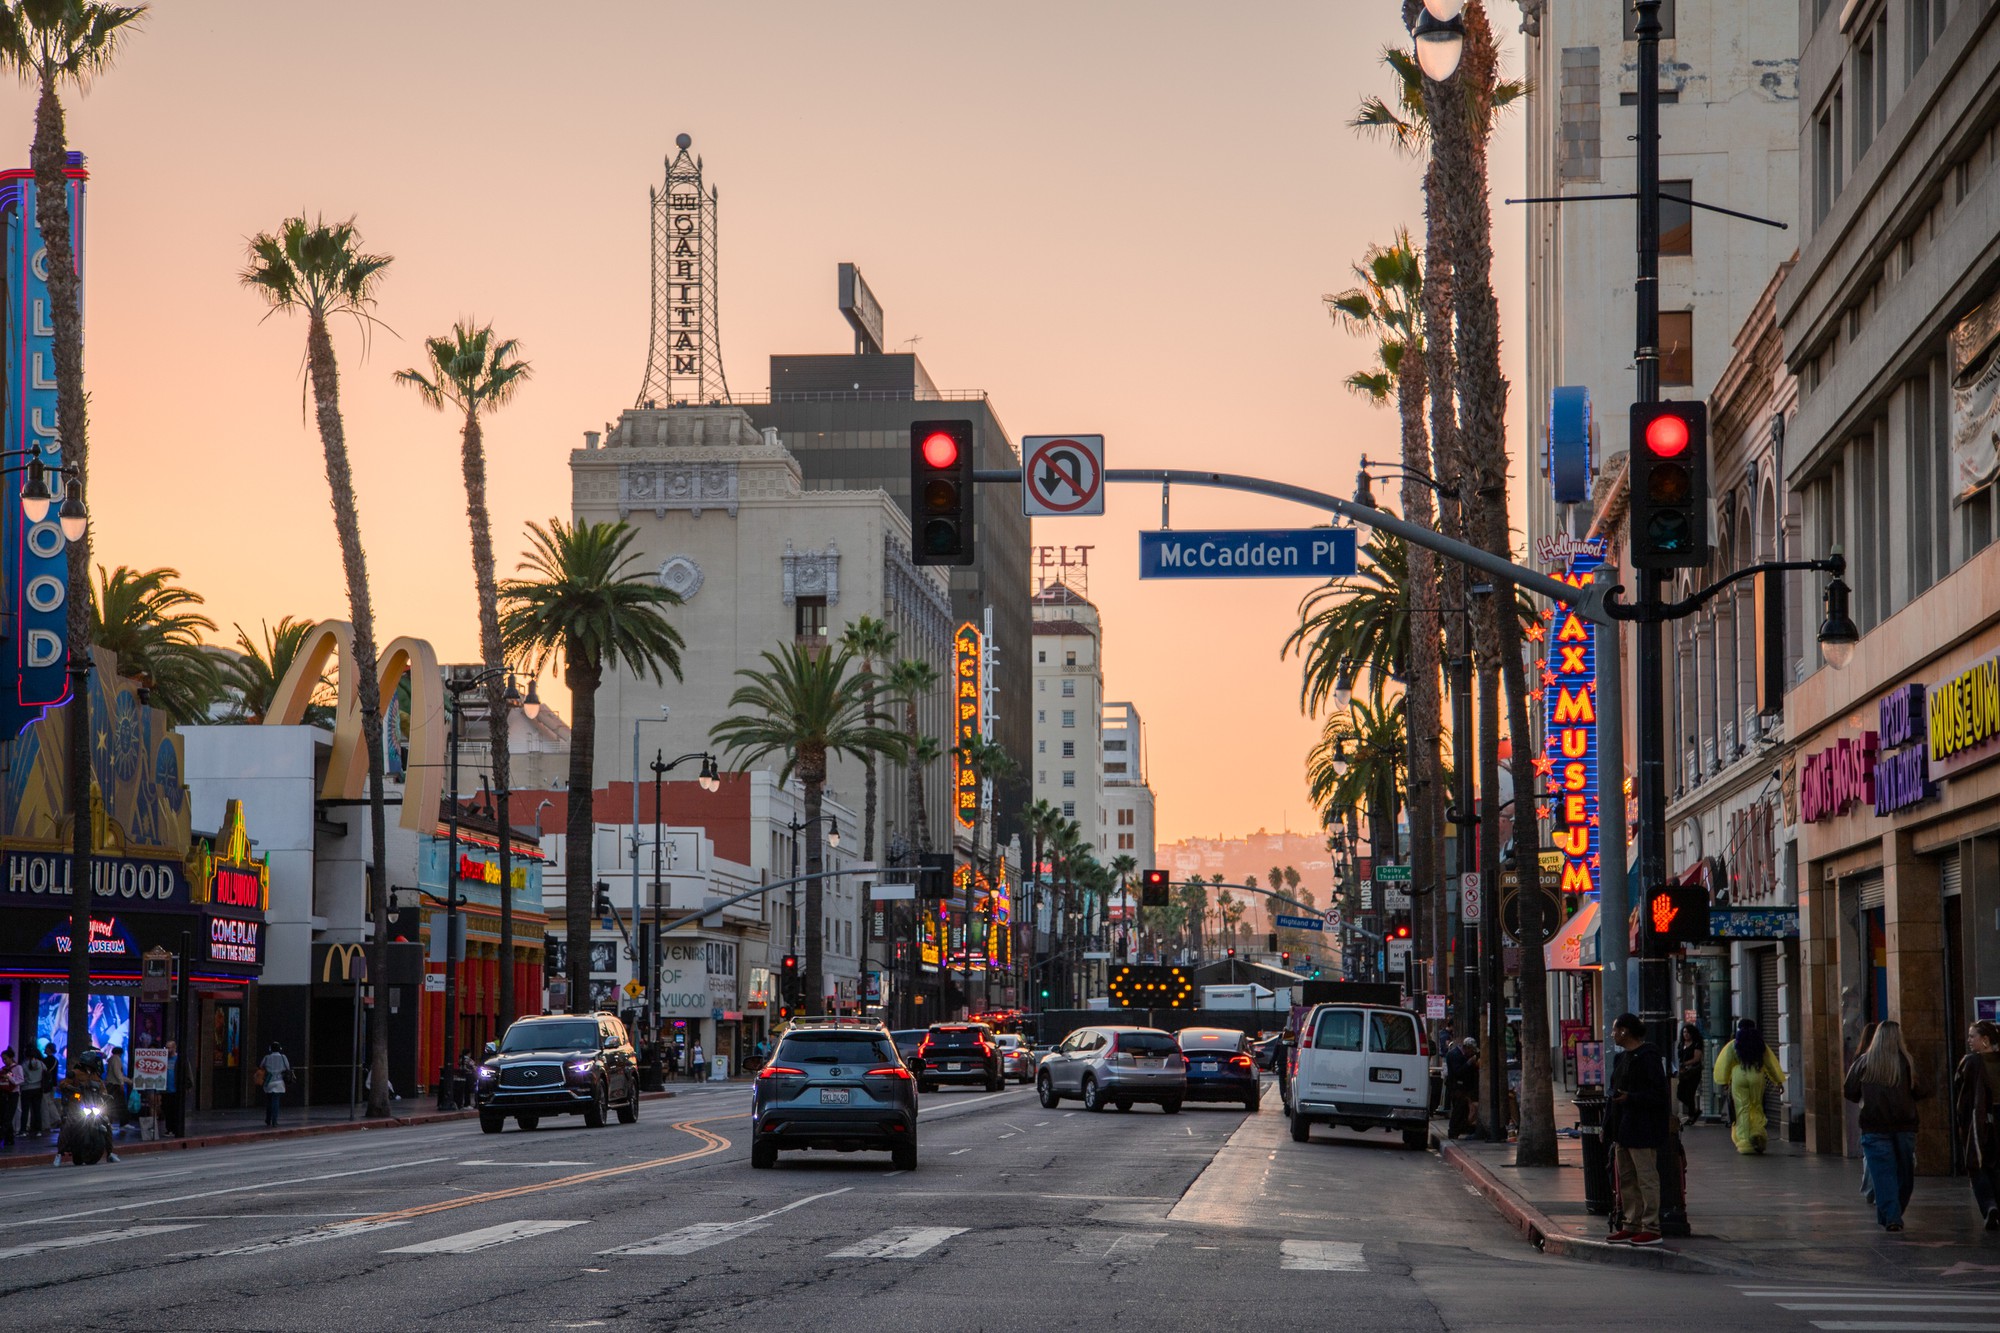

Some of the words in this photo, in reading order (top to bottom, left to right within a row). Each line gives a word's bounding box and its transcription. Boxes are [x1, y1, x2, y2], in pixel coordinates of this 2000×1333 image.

[1031, 545, 1095, 567] ELT
[1161, 542, 1299, 568] McCadden
[1312, 541, 1336, 565] Pl
[1537, 532, 1604, 565] Hollywood
[1879, 684, 1912, 751] UPSIDE
[1929, 655, 2000, 762] MUSEUM
[1552, 684, 1597, 894] MUSEUM
[1832, 732, 1870, 817] HOUSE
[1897, 744, 1924, 809] HOUSE
[9, 855, 176, 900] HOLLWOOD
[217, 870, 259, 908] HOLLYWOOD
[1361, 880, 1373, 910] HADES
[211, 917, 237, 943] COME
[237, 921, 258, 945] PLAY
[874, 912, 884, 937] HADES
[1280, 917, 1309, 928] Highland
[211, 943, 227, 960] WITH
[227, 945, 238, 961] THE
[953, 927, 962, 949] HADES
[623, 946, 705, 961] SVENIRS
[662, 969, 682, 983] OF
